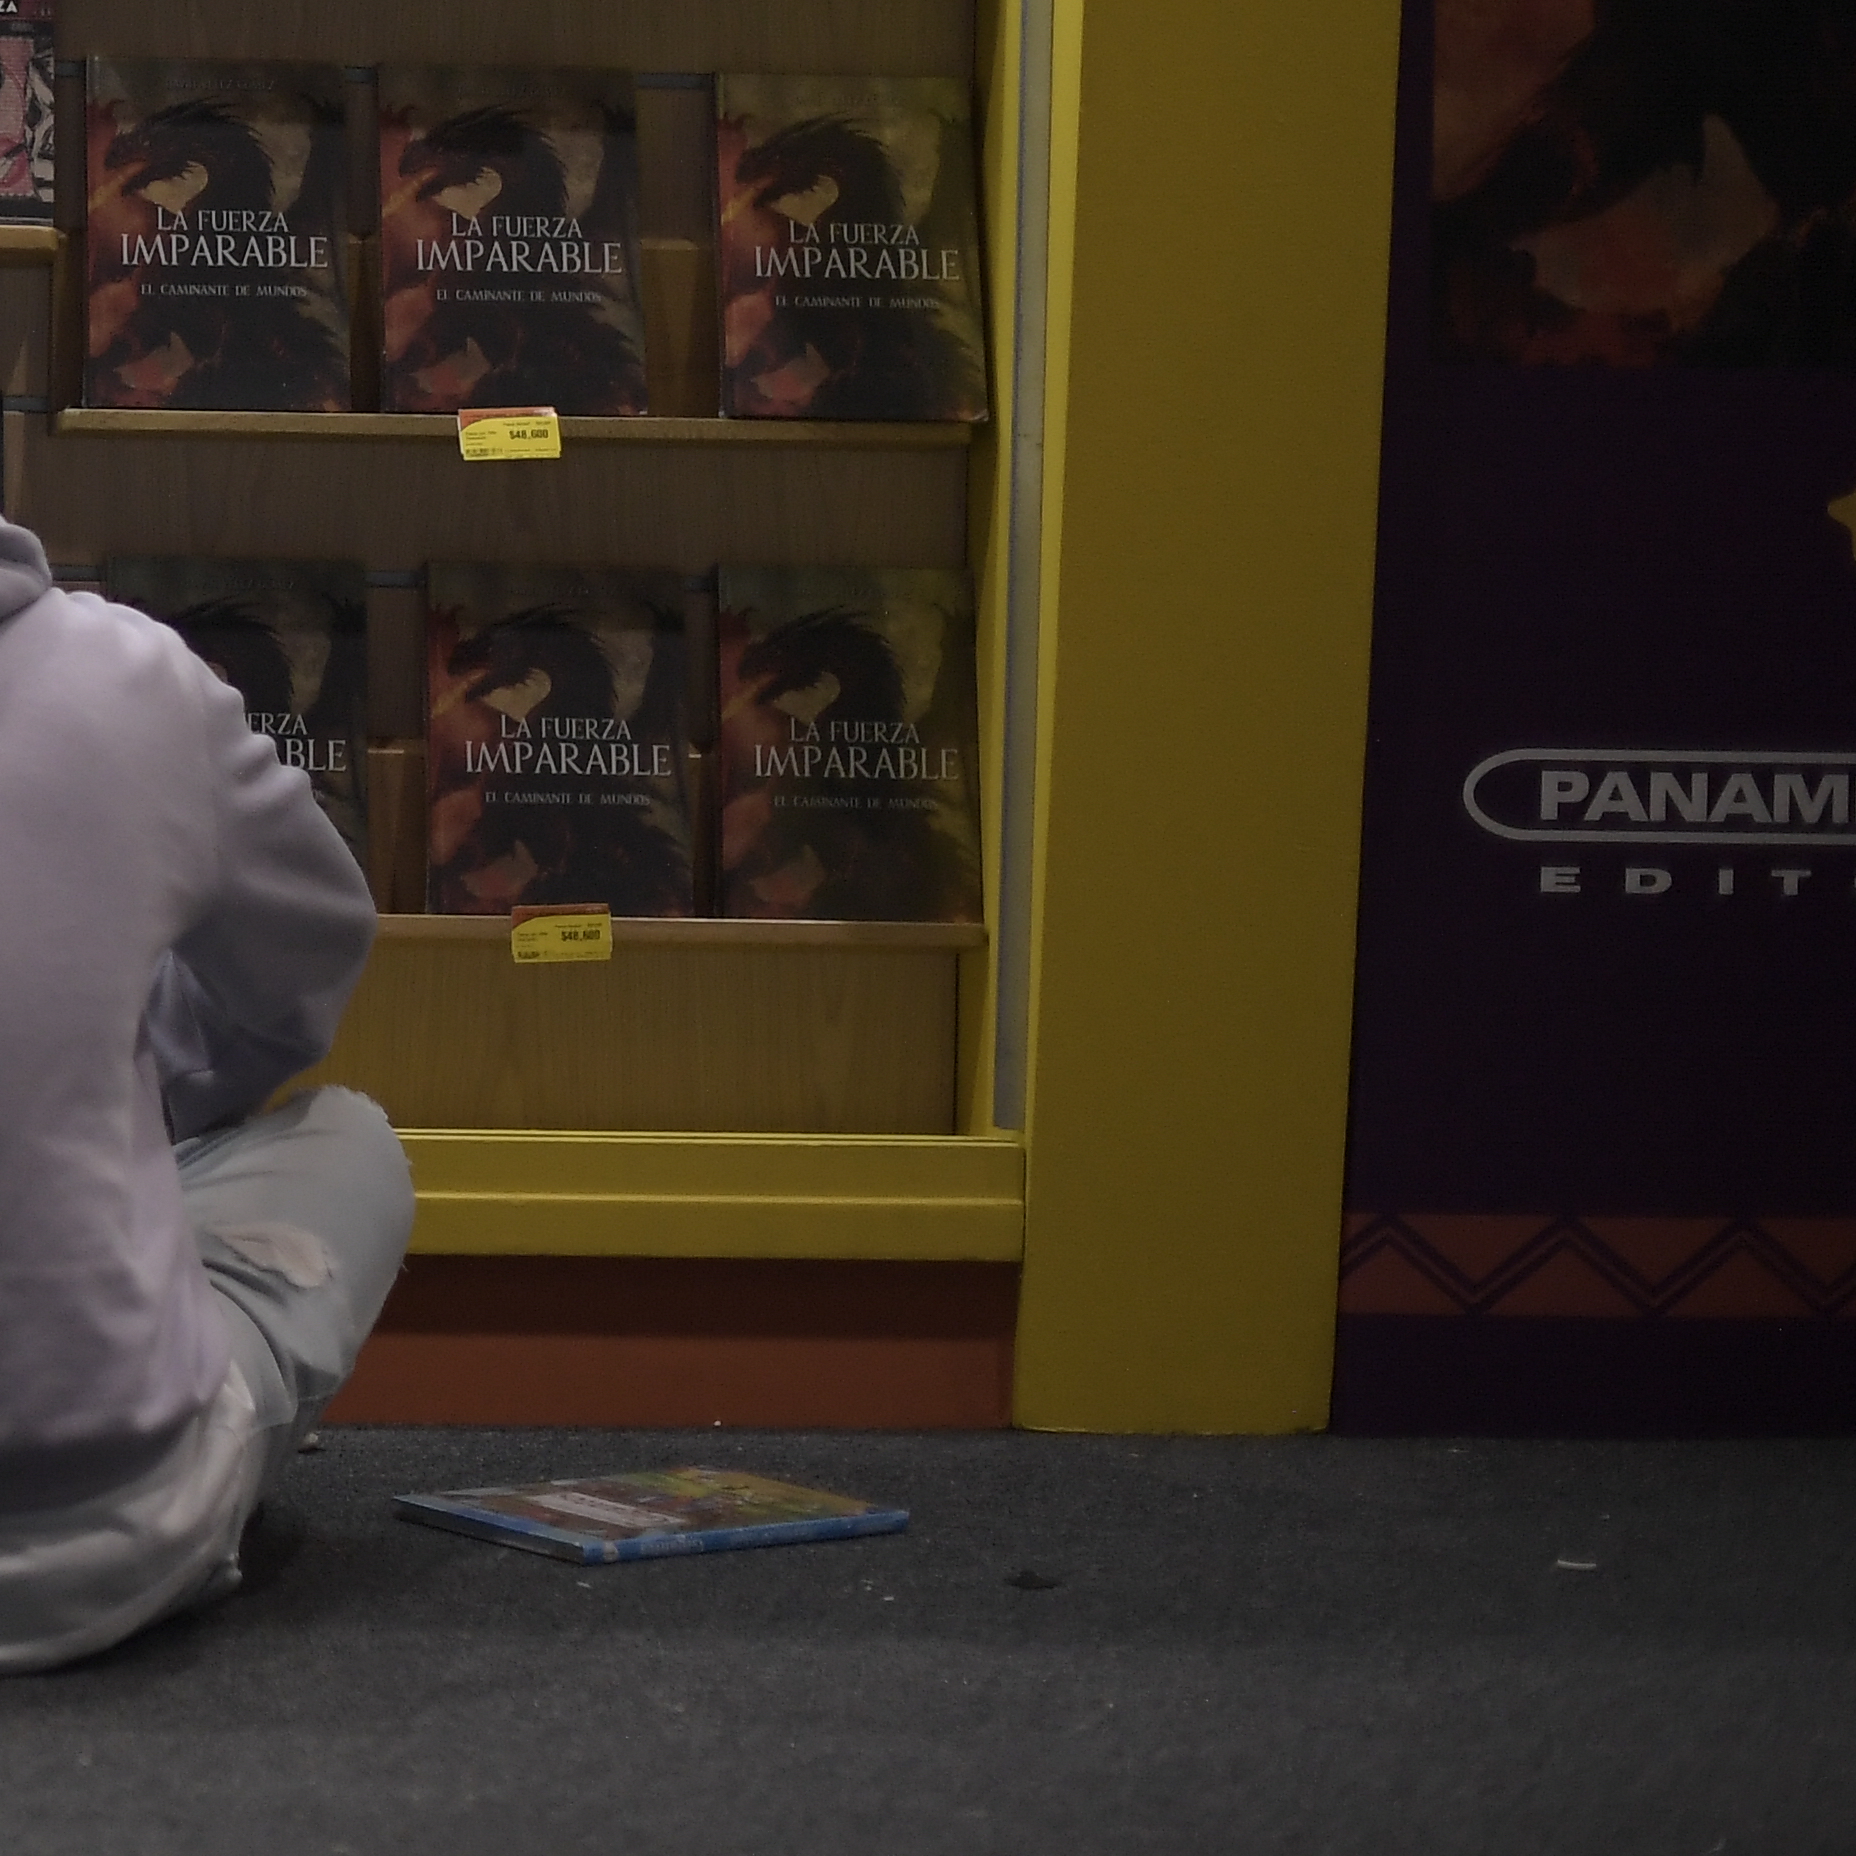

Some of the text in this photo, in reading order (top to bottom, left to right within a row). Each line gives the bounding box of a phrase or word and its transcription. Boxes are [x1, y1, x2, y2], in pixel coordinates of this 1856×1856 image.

[121, 233, 328, 269] IMPARABLE
[465, 743, 672, 778] IMPARABLE
[1540, 770, 1856, 824] PANAM
[1540, 866, 1856, 896] EDIT
